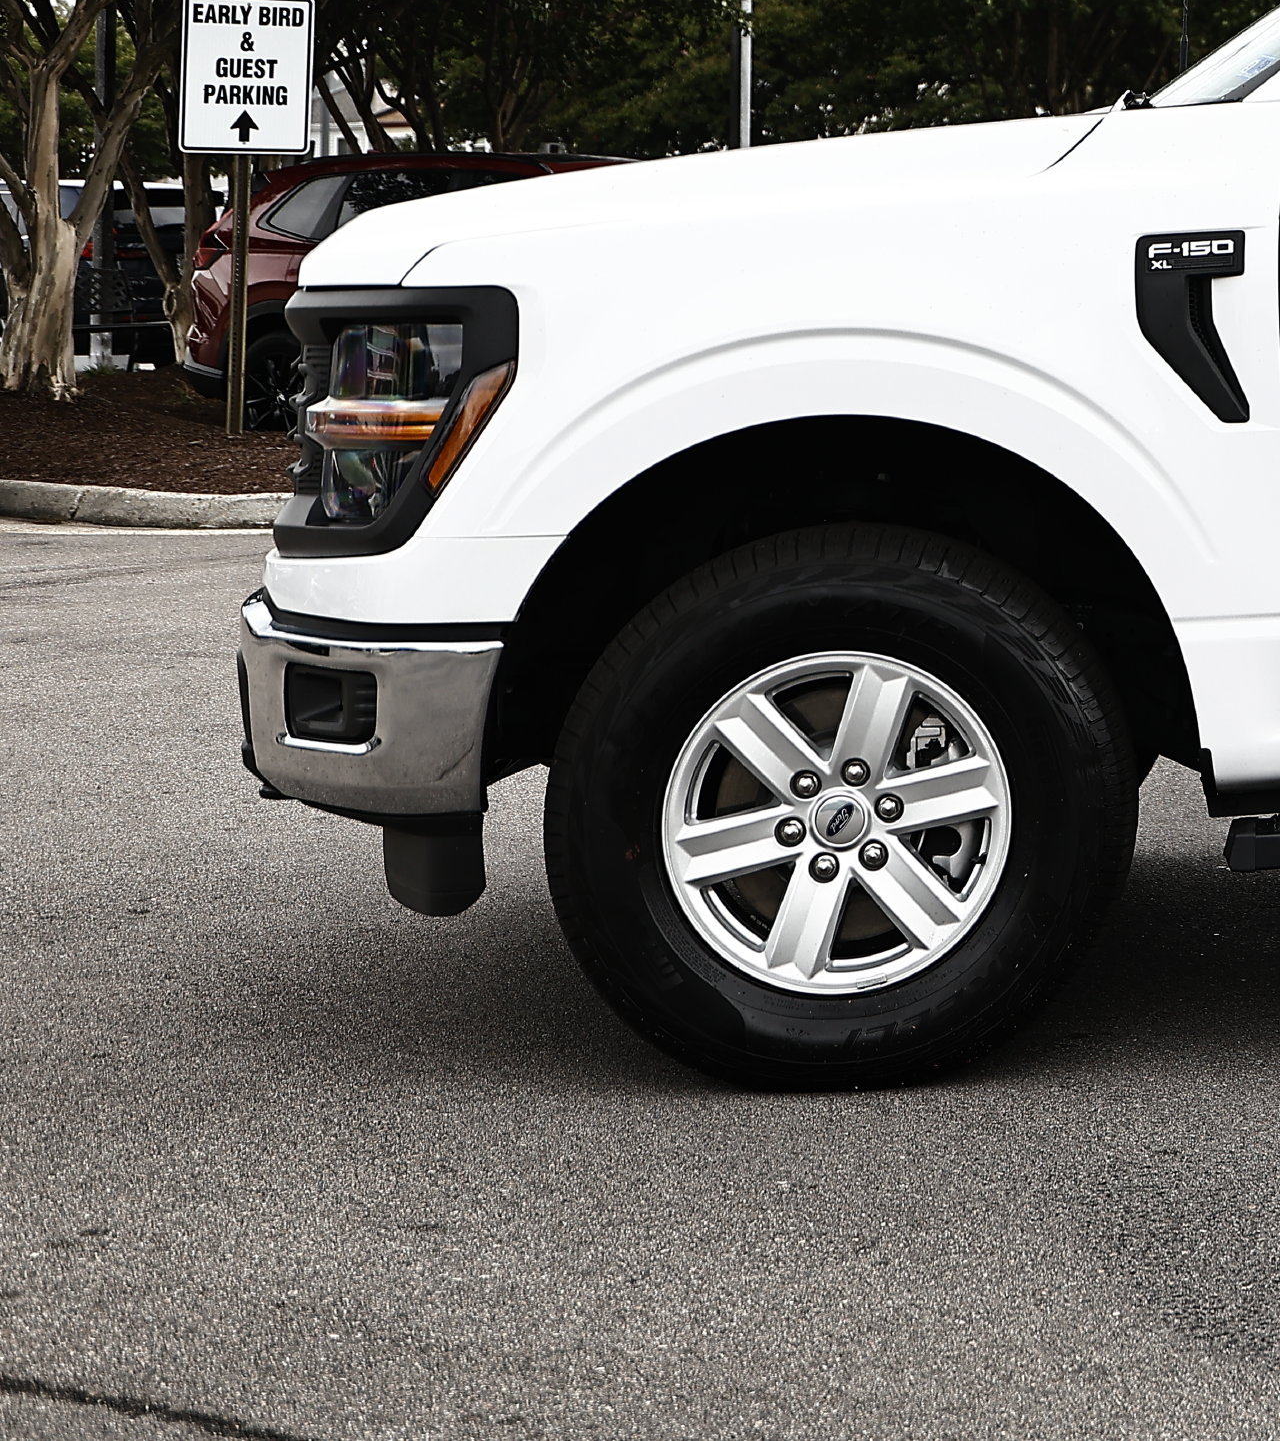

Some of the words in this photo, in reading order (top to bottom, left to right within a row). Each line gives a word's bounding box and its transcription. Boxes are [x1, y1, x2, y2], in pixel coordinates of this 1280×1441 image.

[192, 3, 252, 25] EARLY
[258, 6, 304, 27] BIRD
[240, 31, 255, 52] &
[215, 57, 278, 79] GUEST
[203, 84, 288, 106] PARKING
[1148, 239, 1235, 259] F-150
[1150, 260, 1173, 270] XL
